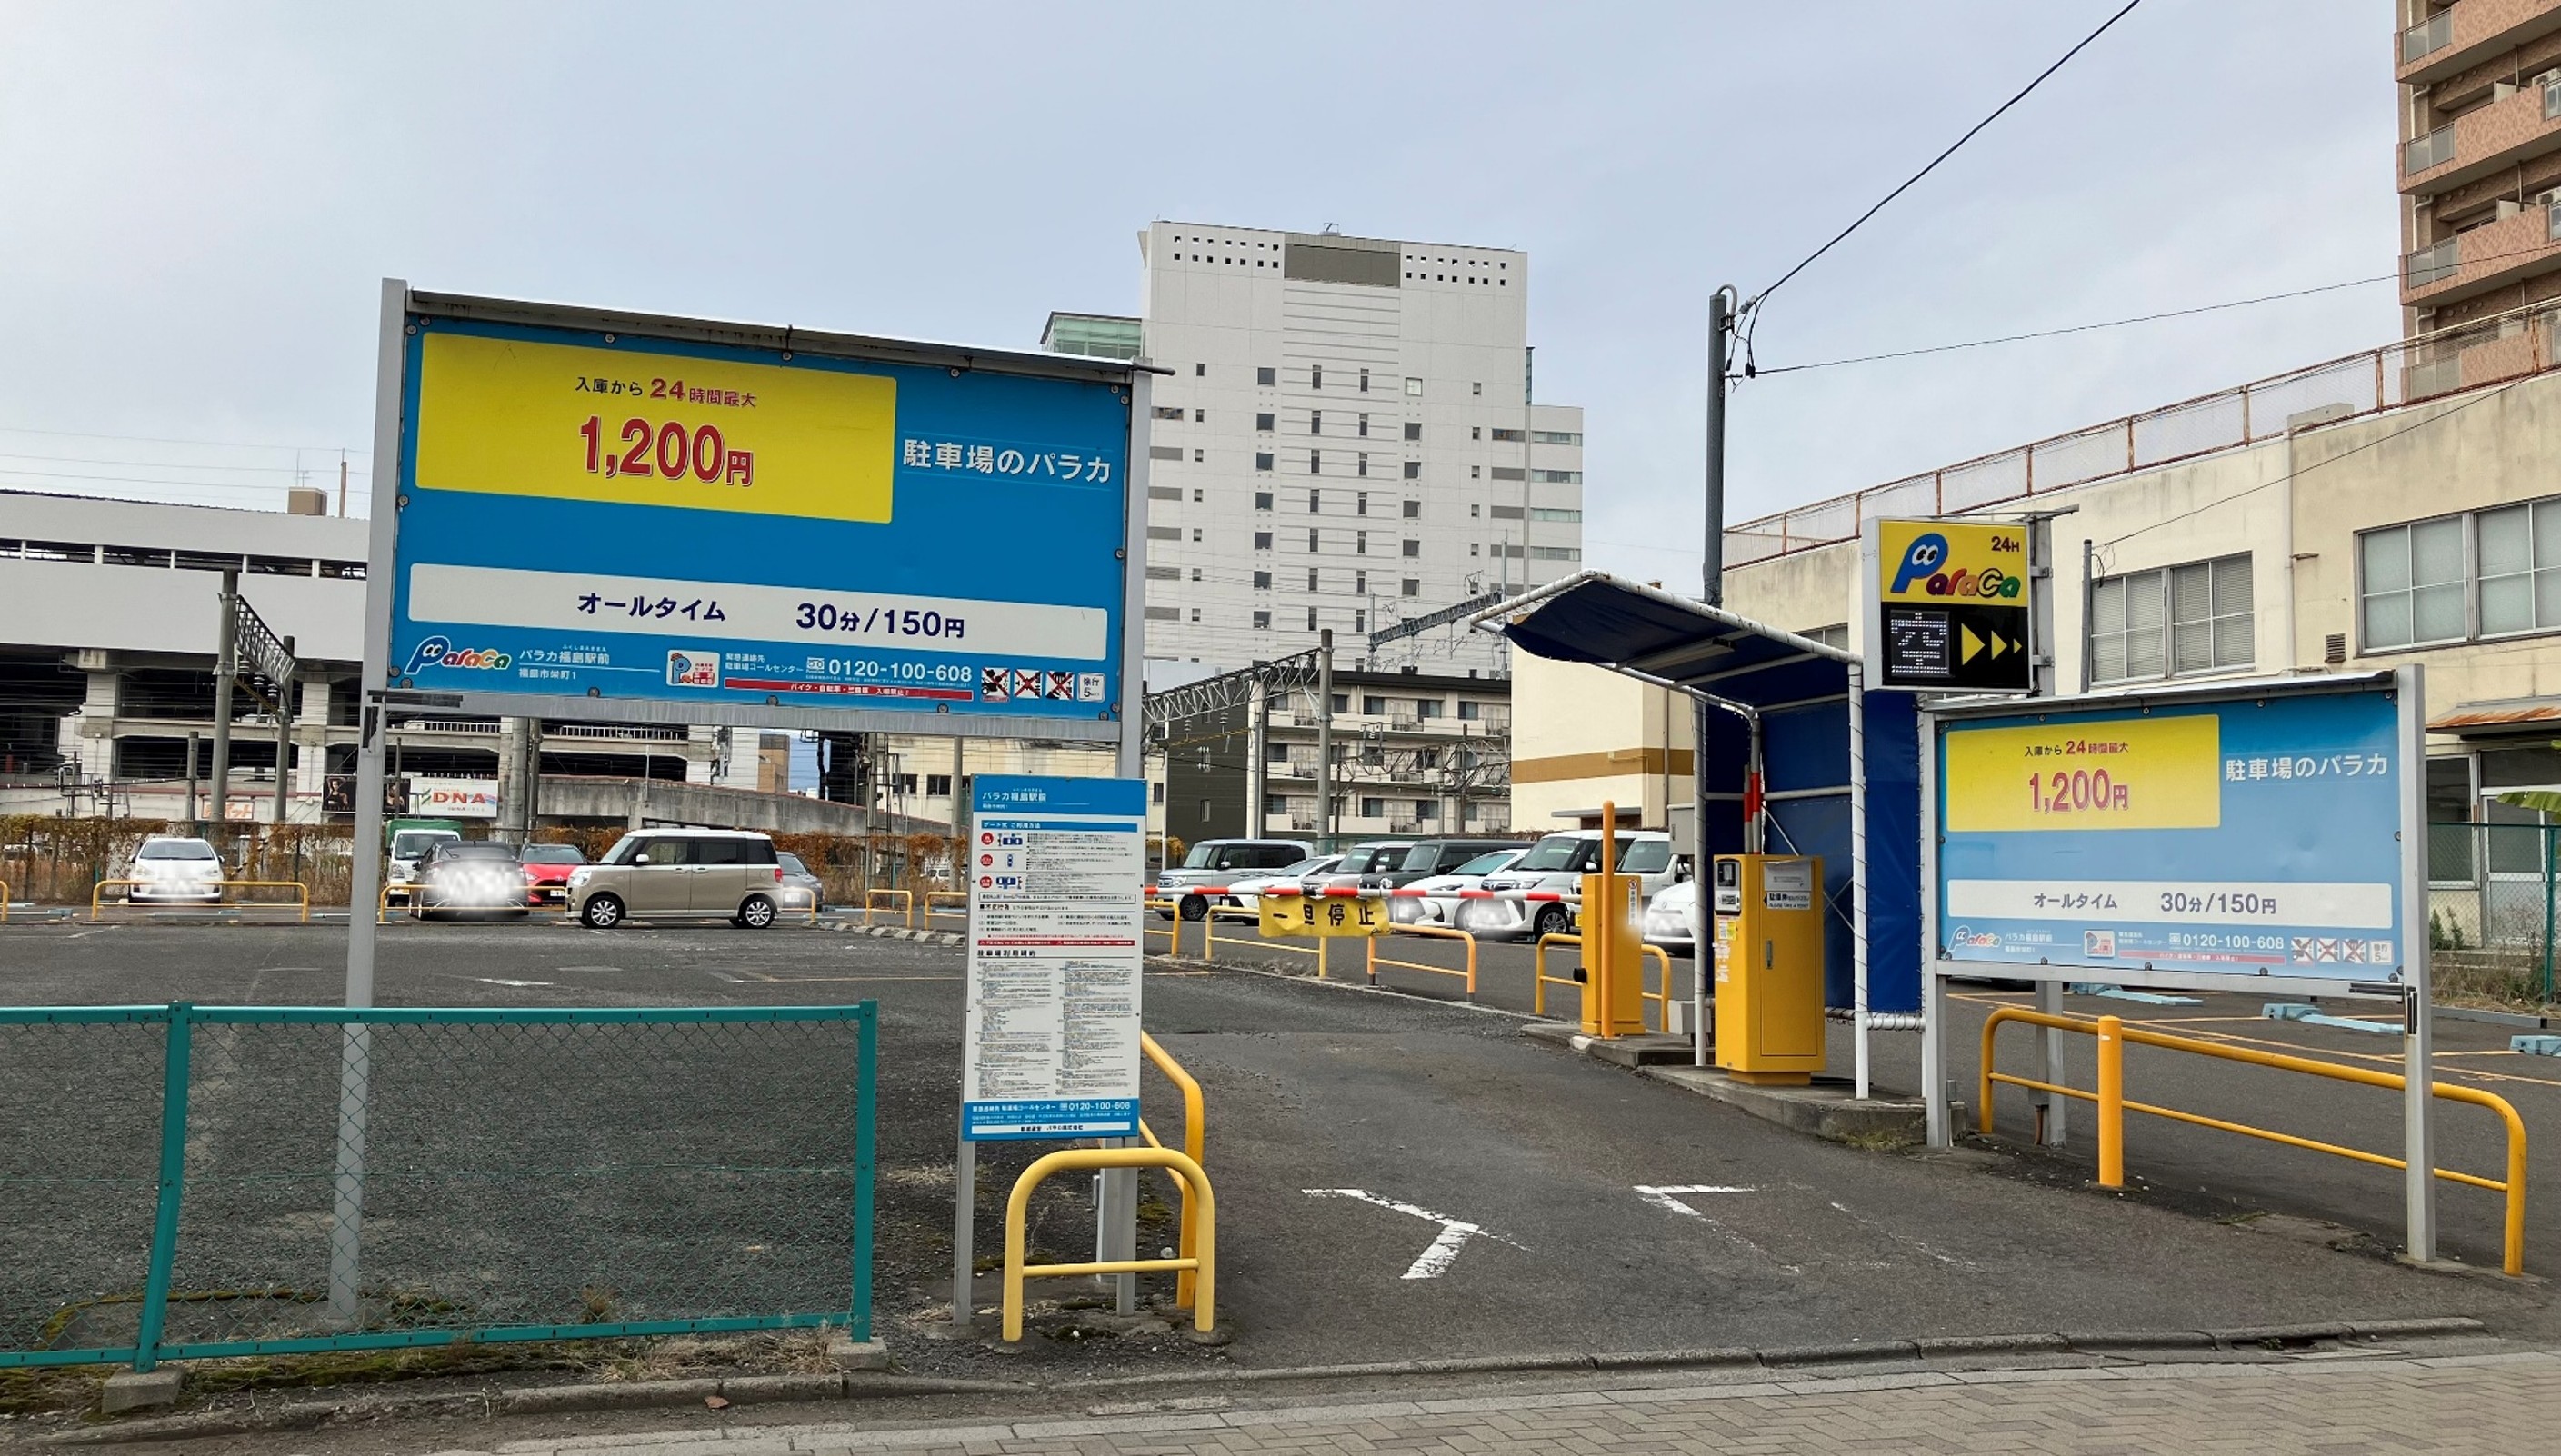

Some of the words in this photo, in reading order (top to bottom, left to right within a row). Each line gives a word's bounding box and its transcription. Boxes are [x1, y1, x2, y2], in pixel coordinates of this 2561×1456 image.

[580, 415, 755, 486] 1,200円
[903, 439, 1111, 484] 駐車場のパラカ
[1991, 536, 2020, 553] 24H
[578, 593, 726, 623] オールタイム
[796, 603, 965, 639] 30分/150円
[1891, 612, 1947, 674] 空
[828, 659, 973, 682] 0120-100-608
[2226, 753, 2388, 782] 駐車場のパラカ
[433, 792, 485, 803] DNA
[2029, 768, 2129, 813] 1,200円
[1273, 903, 1375, 926] 一旦停止
[2034, 893, 2118, 910] オールタイム
[2160, 893, 2276, 914] 30分/150円
[2183, 933, 2285, 950] 0120-100-608
